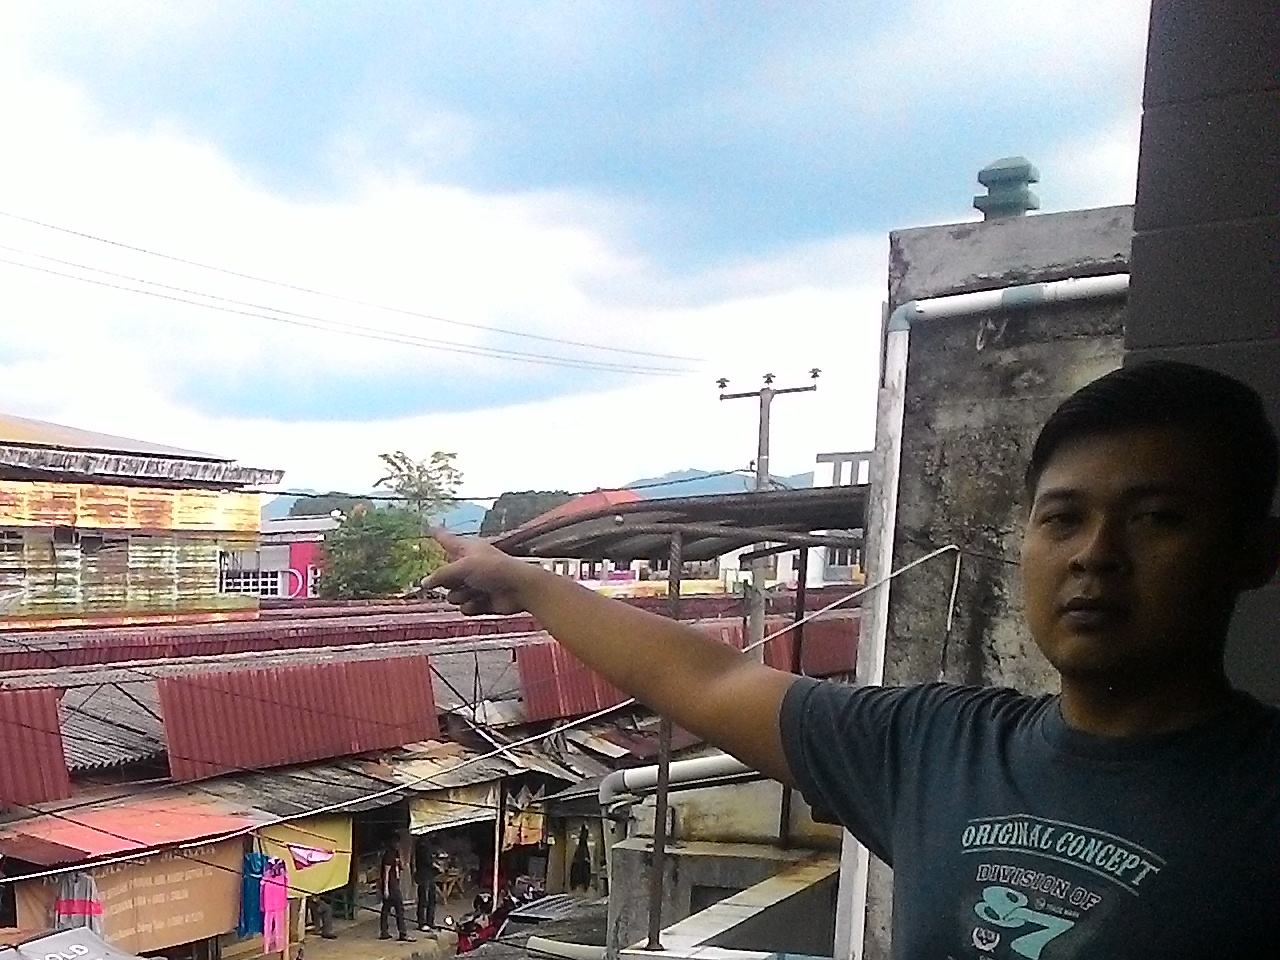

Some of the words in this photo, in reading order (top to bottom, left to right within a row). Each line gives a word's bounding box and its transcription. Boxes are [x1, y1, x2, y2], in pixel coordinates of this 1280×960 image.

[961, 821, 1055, 850] ORIGINAL
[1056, 831, 1161, 886] CONCEPT
[976, 863, 1070, 899] DIVISION
[1069, 886, 1101, 911] OF
